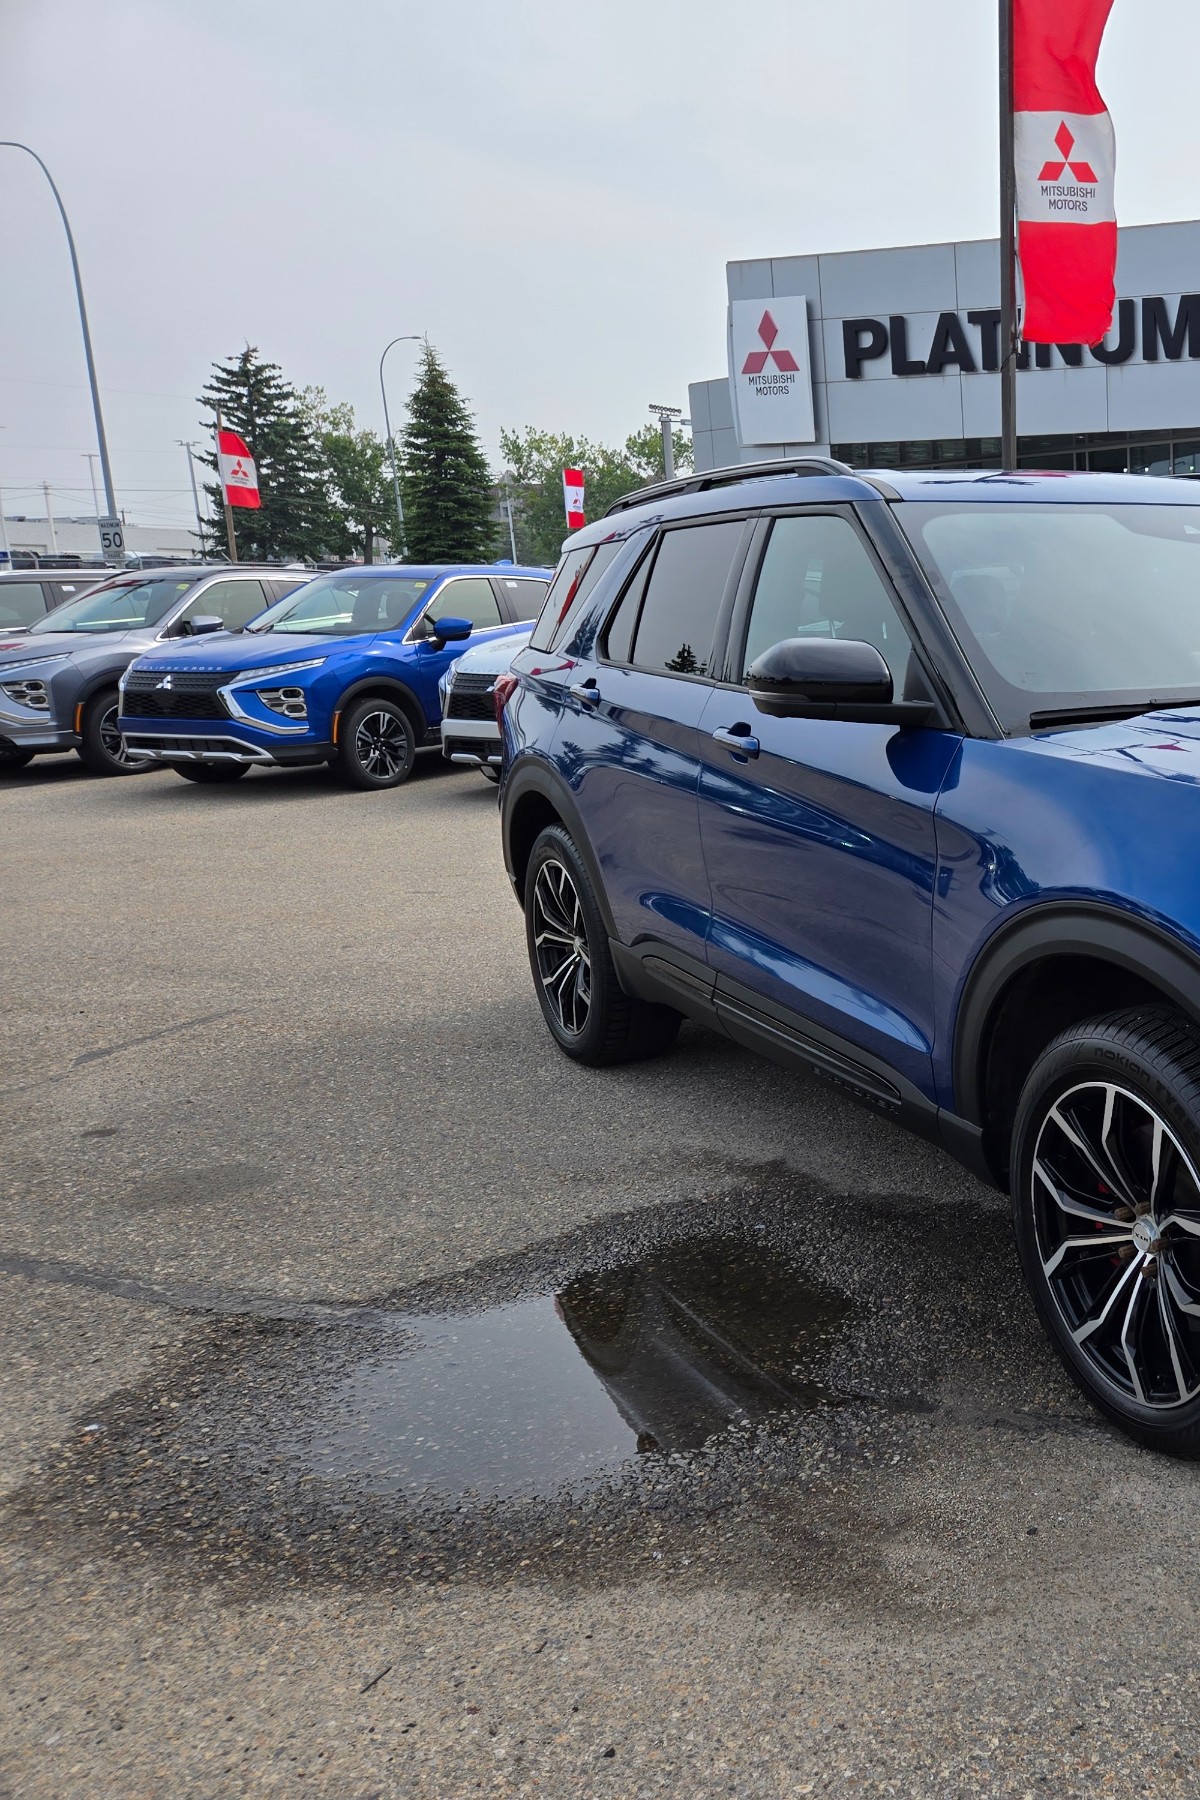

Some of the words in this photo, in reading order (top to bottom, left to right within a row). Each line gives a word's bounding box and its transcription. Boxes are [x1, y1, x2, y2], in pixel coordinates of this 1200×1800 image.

[1041, 185, 1096, 198] MITSUBISHI
[1048, 198, 1088, 211] MOTORS
[748, 374, 795, 386] MITSUBISHI
[755, 385, 790, 397] MOTORS
[102, 532, 123, 549] 50
